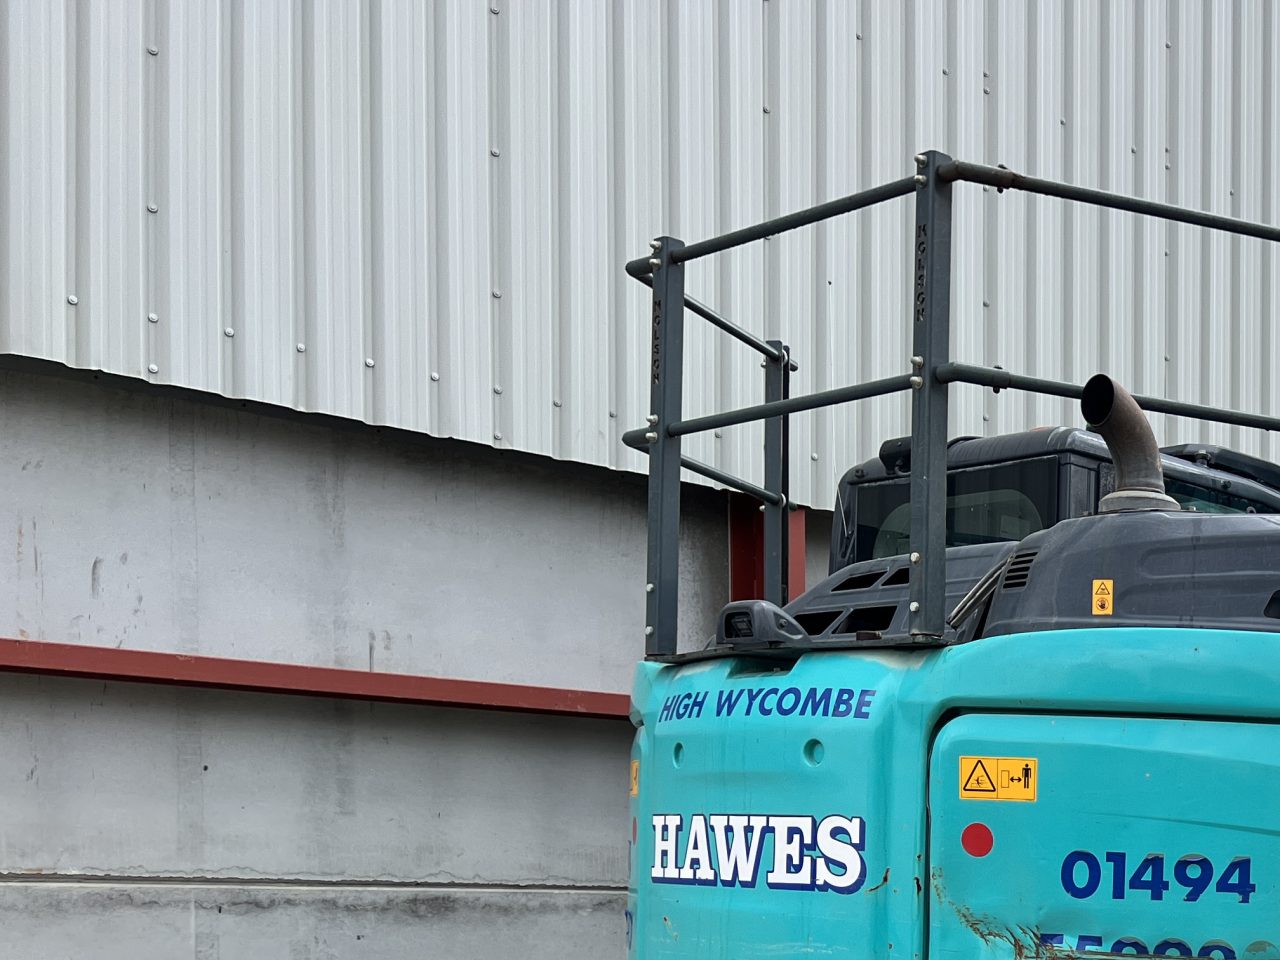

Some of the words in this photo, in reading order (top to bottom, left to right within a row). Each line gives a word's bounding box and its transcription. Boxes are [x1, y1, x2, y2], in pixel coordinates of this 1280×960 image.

[659, 691, 708, 722] HIGH
[715, 687, 877, 719] WYCOMBE
[651, 814, 866, 895] HAWES
[1060, 850, 1256, 904] 01494
